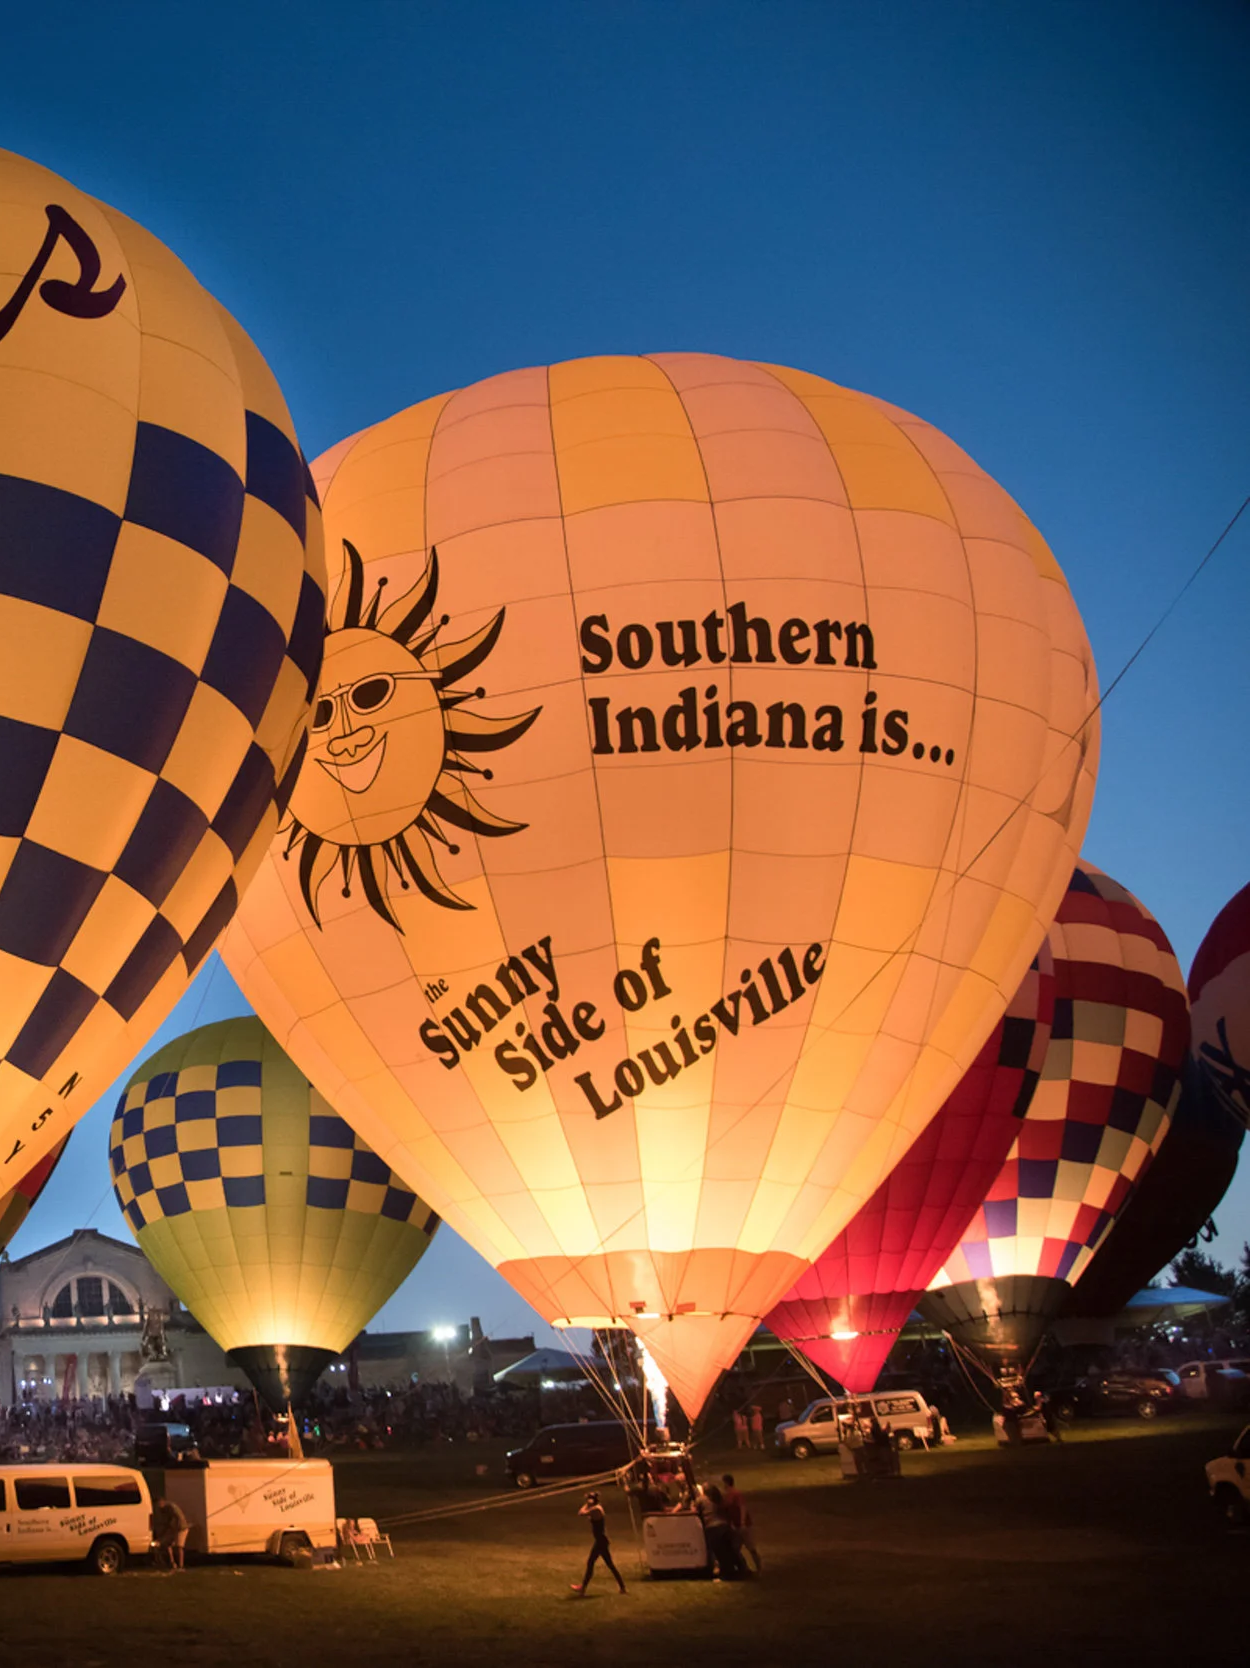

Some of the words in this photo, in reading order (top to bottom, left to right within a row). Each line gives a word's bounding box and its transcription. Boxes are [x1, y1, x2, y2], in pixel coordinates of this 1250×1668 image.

[579, 601, 878, 674] Southern
[588, 684, 845, 755] Indiana
[858, 690, 955, 766] is...
[418, 935, 561, 1071] Sunny
[424, 975, 450, 1004] the
[494, 1000, 606, 1093] Side
[613, 936, 673, 1013] of
[573, 941, 827, 1121] Louisville
